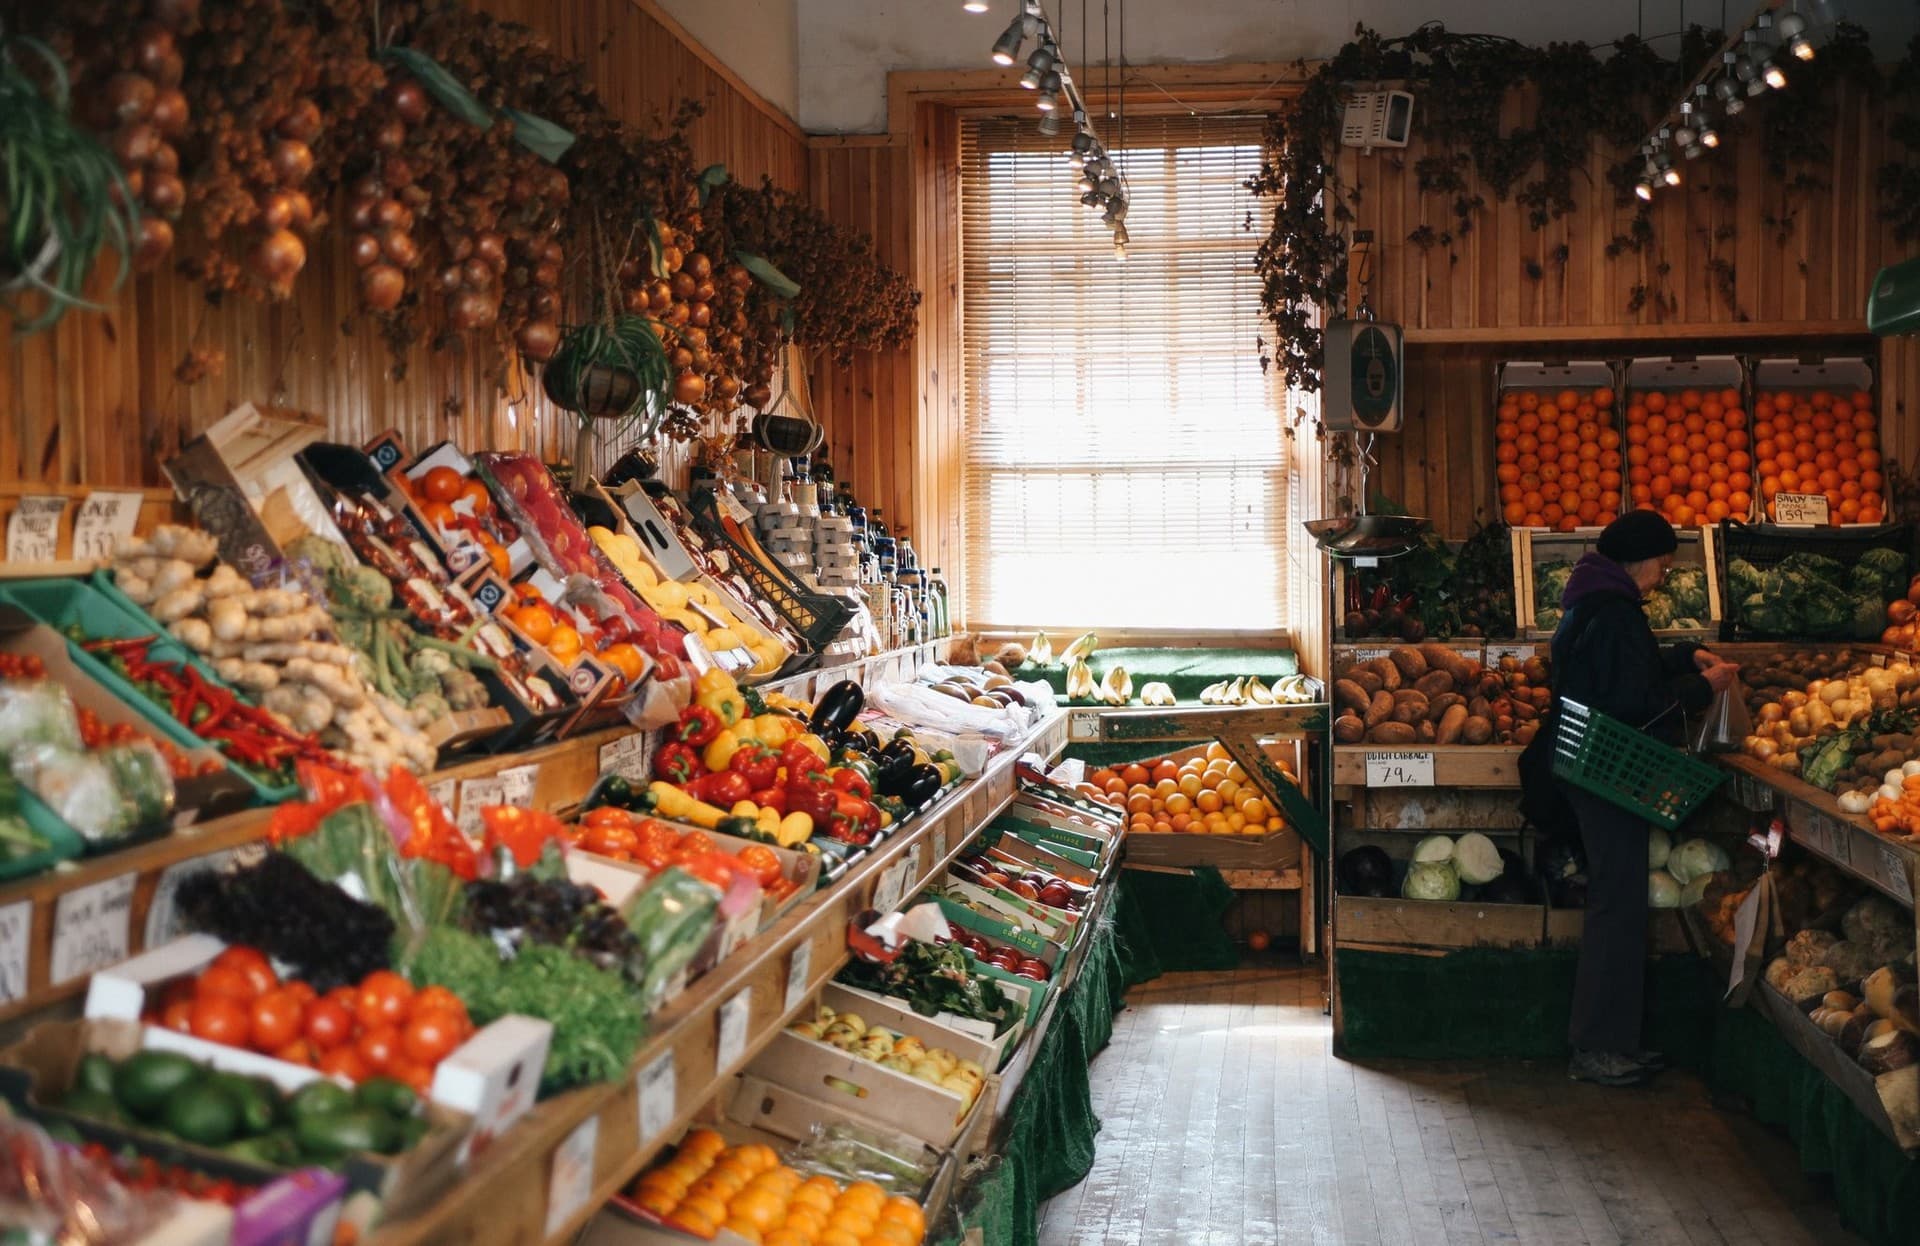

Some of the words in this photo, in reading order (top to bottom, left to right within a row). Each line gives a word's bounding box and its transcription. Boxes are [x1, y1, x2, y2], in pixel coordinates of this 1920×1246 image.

[1777, 495, 1807, 505] SAVOY
[1367, 752, 1392, 761] DUTCH
[1393, 752, 1429, 761] CABBAGE
